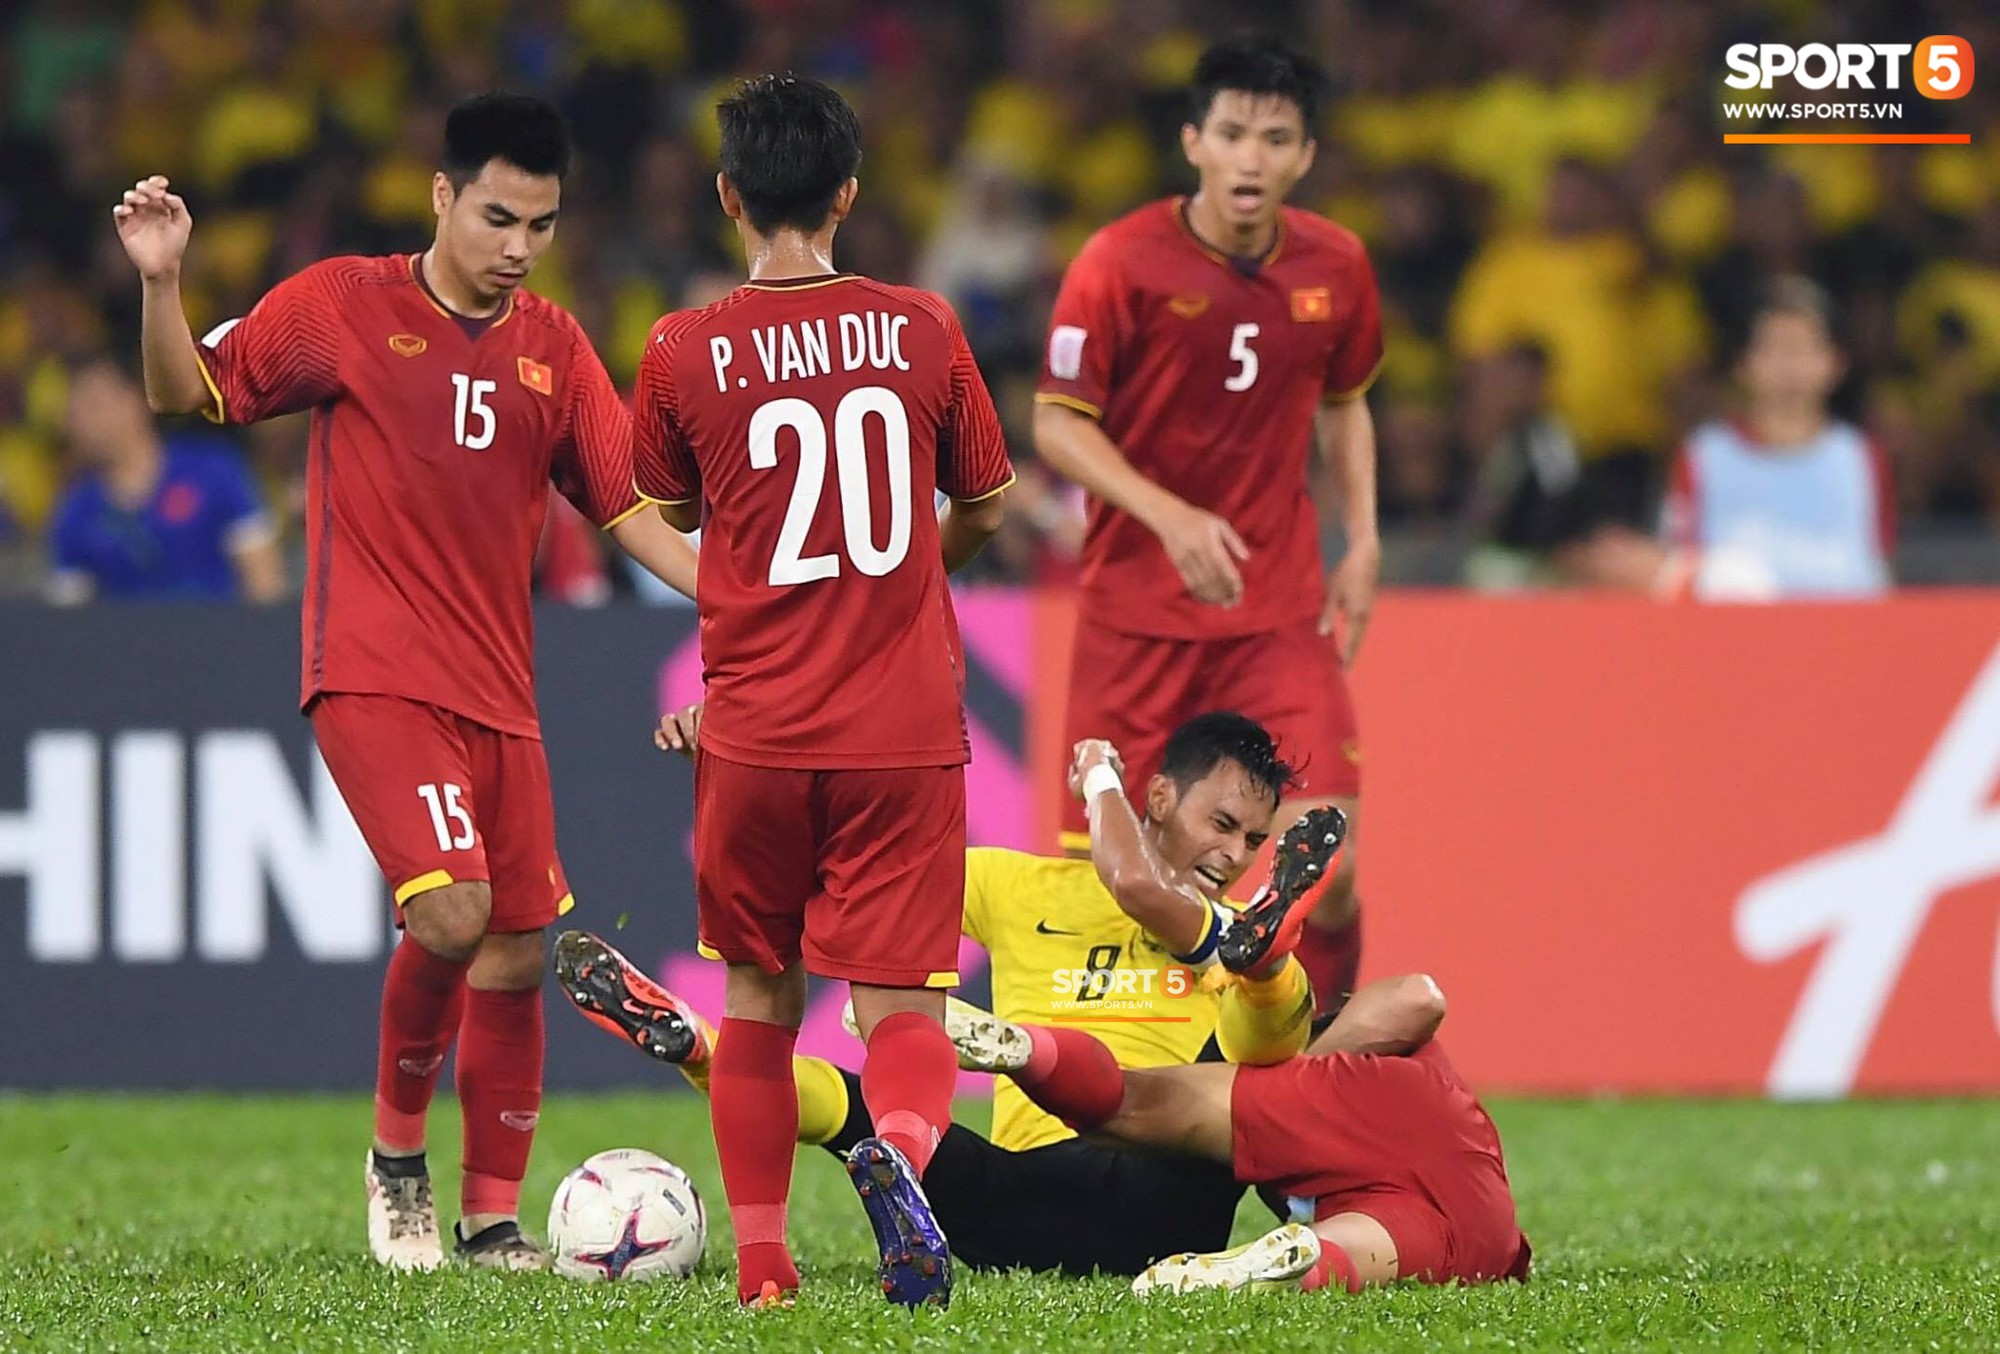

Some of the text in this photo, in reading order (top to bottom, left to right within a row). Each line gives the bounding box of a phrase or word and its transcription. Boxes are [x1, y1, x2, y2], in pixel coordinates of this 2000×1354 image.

[710, 311, 910, 392] P. VAN DUC
[1224, 323, 1260, 391] 5
[452, 373, 496, 450] 15
[747, 386, 912, 586] 20
[0, 730, 404, 962] HIN
[417, 782, 476, 852] 15
[1076, 944, 1122, 1002] 8
